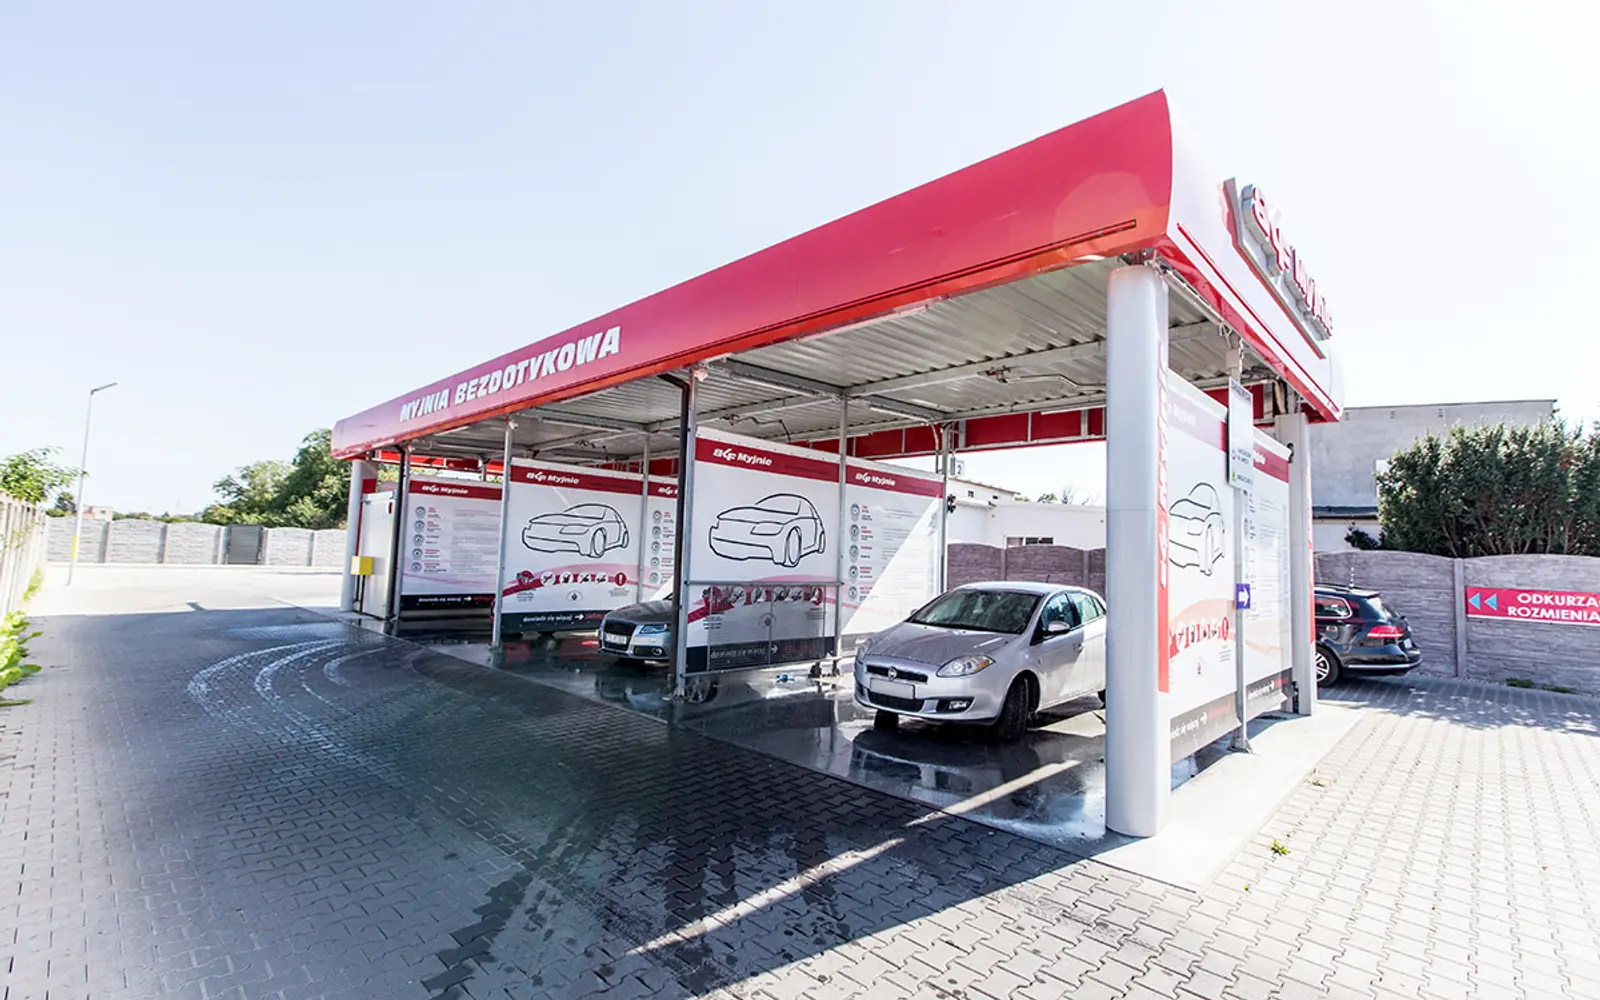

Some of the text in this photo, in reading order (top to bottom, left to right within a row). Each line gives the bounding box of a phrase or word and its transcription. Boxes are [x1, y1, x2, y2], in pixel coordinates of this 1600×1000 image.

[400, 326, 621, 422] MYJNIA BEZDOTYKOWA
[737, 452, 772, 467] Myjnie
[957, 464, 963, 475] 2
[1517, 593, 1600, 607] ODKURZA
